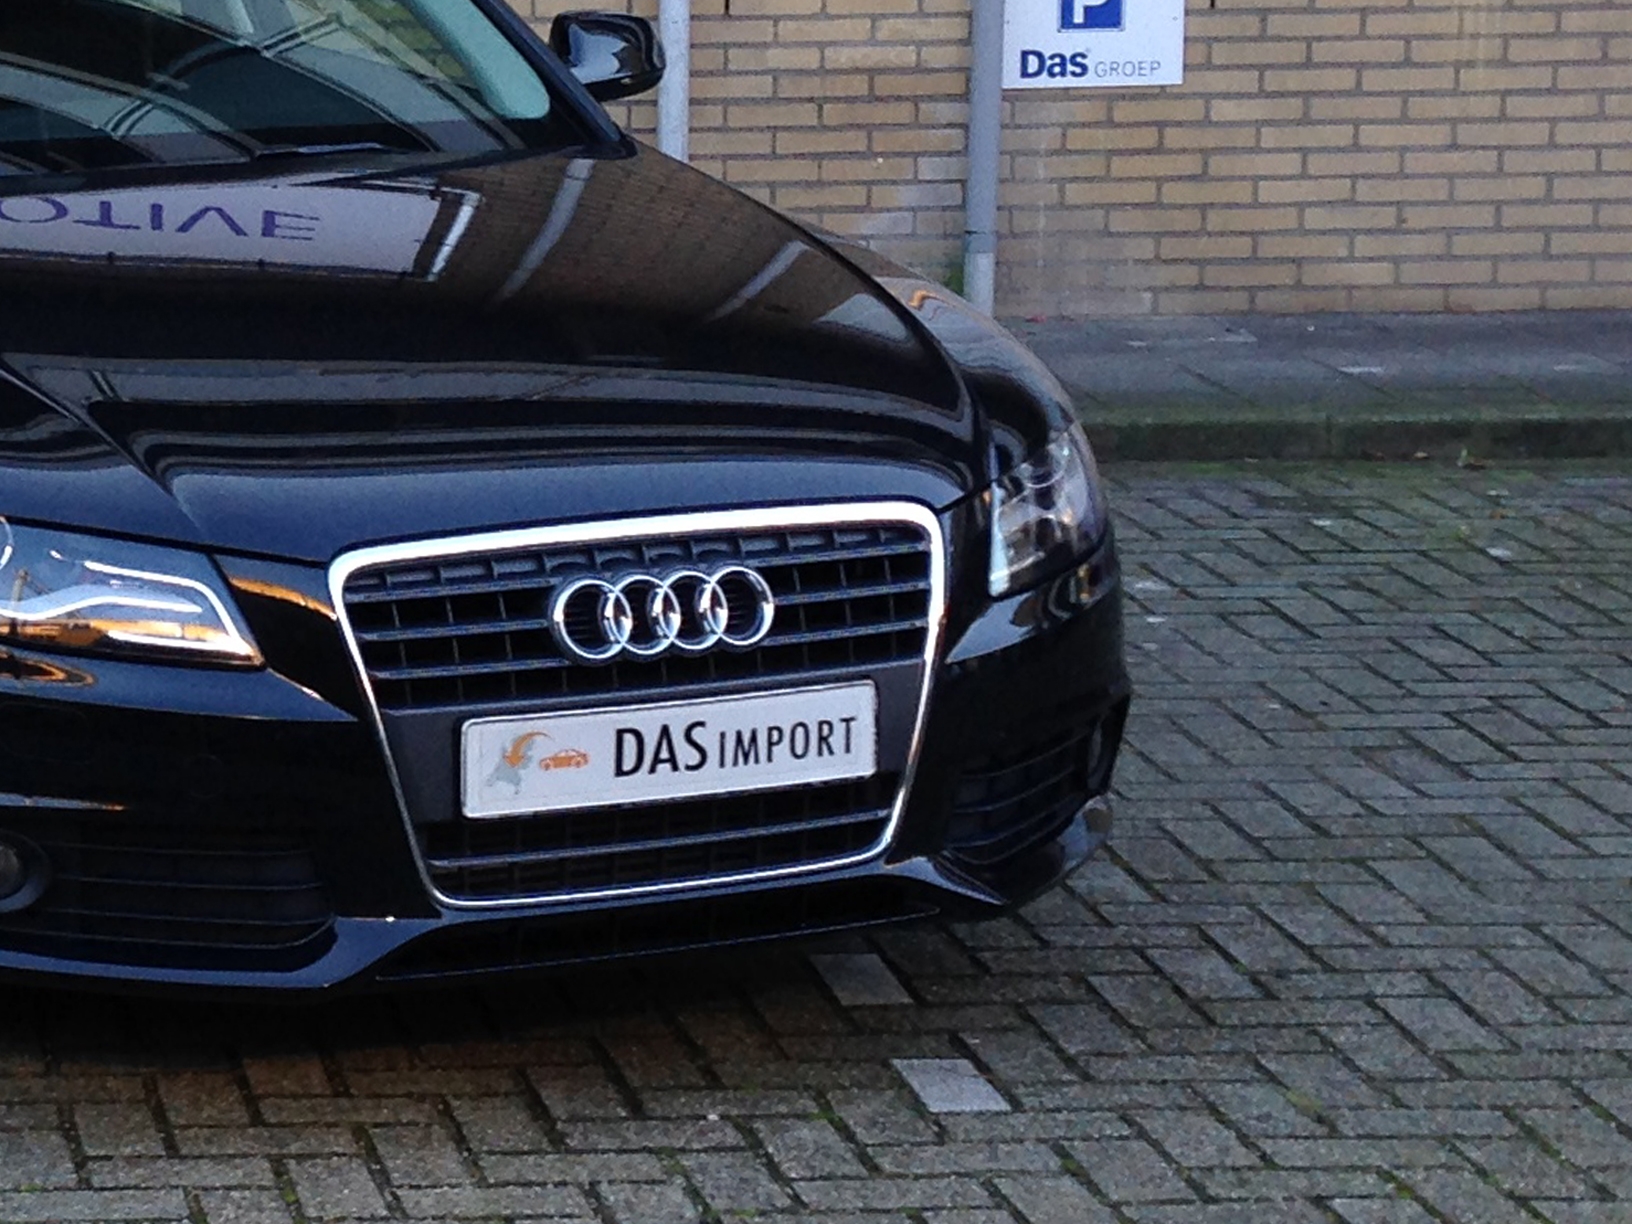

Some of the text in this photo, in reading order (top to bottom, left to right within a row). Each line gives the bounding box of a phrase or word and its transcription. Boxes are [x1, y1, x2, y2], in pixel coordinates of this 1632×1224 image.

[1020, 50, 1161, 78] Das GROEP
[614, 717, 856, 777] DAS IMPORT
